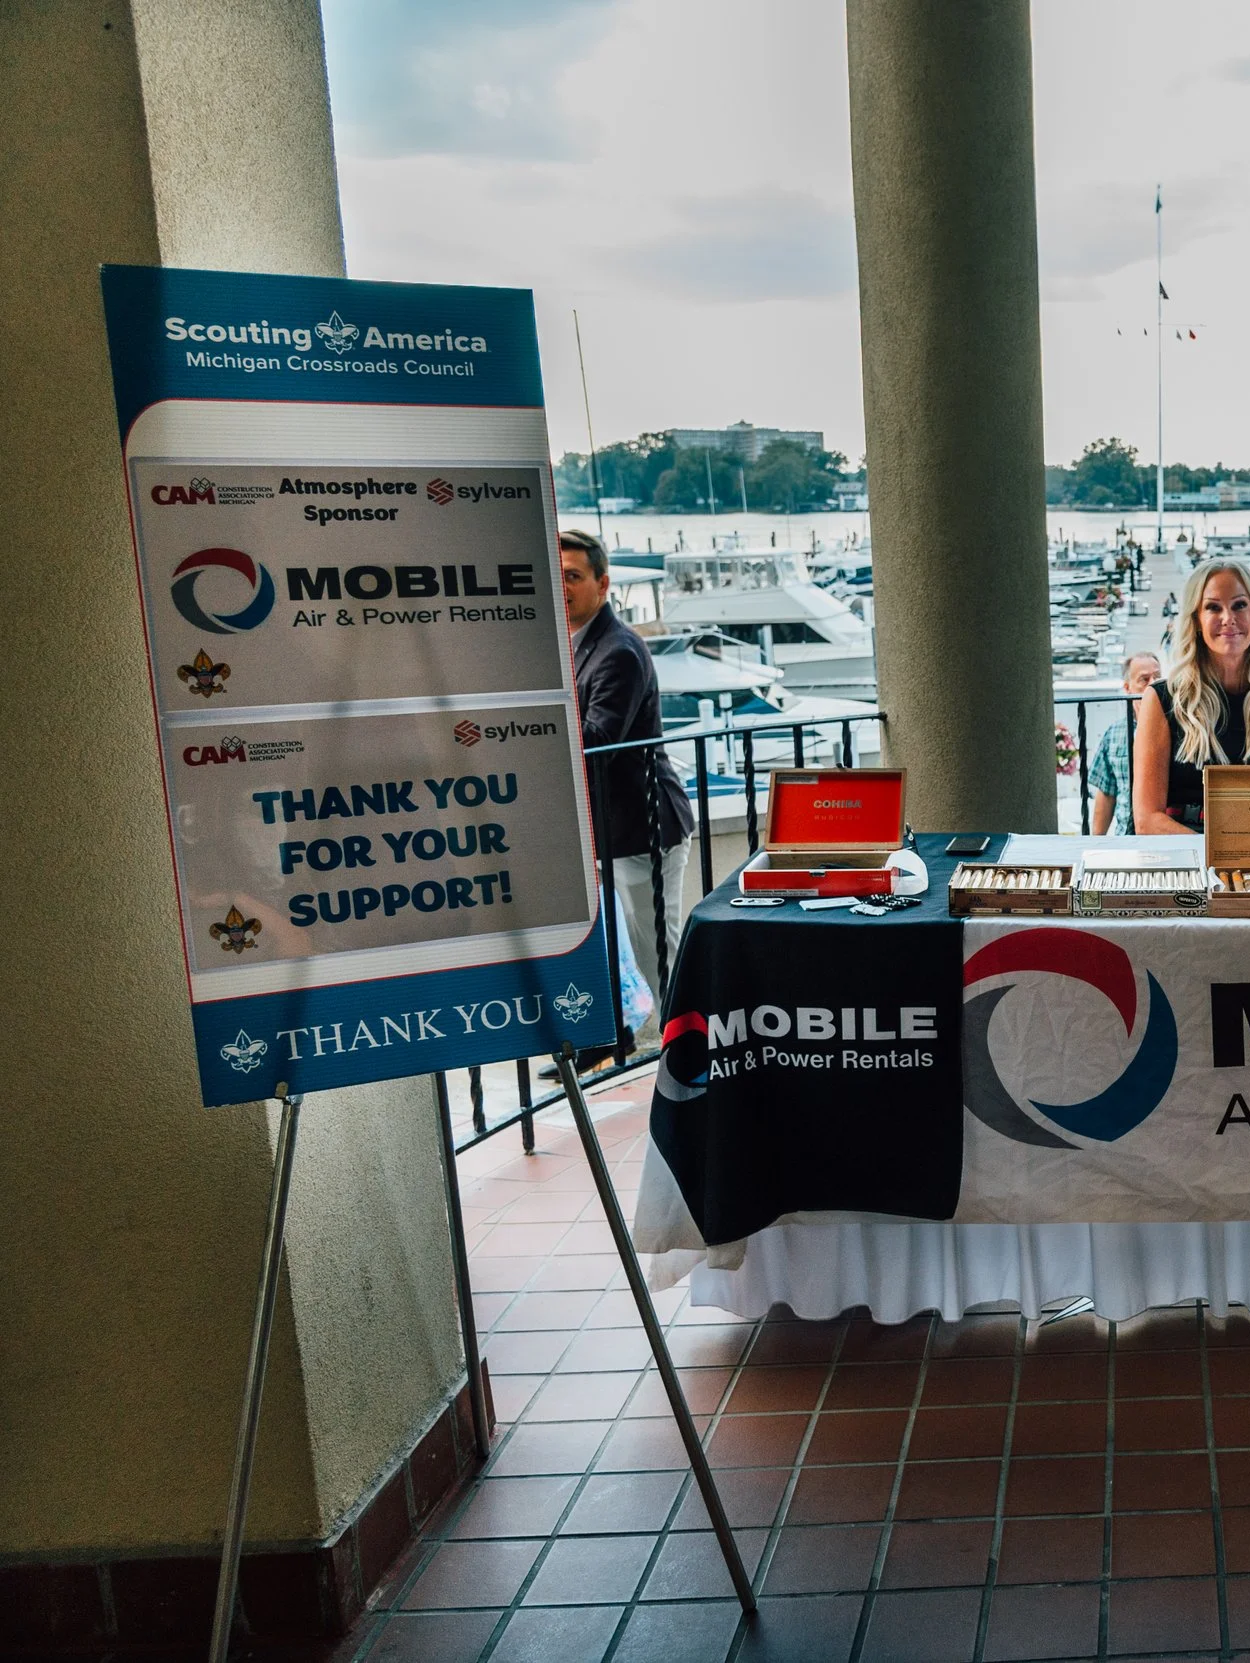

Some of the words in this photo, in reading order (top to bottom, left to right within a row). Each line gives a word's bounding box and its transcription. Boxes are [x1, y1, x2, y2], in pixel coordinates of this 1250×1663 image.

[165, 317, 312, 352] Scouting
[363, 326, 488, 353] America
[186, 351, 281, 372] Michigan
[286, 355, 399, 375] Crossroads
[403, 359, 475, 377] Council
[151, 484, 216, 506] CAM
[278, 477, 418, 499] Atmosphere
[457, 481, 531, 503] sylvan
[303, 505, 399, 527] Sponsor
[285, 563, 536, 602] MOBILE
[292, 608, 327, 628] Air
[336, 608, 356, 627] &
[362, 607, 441, 626] Power
[449, 603, 536, 623] Rentals
[248, 740, 303, 749] CONSTRUCTION
[484, 719, 557, 746] sylvan
[183, 744, 247, 767] CAM
[248, 747, 295, 756] ASSOCIATION
[249, 754, 286, 762] MICHIGAN
[252, 780, 419, 825] THANK
[424, 772, 518, 809] YOU
[813, 799, 862, 809] COHIBA
[280, 836, 377, 875] FOR
[382, 823, 510, 864] YOUR
[288, 870, 512, 928] SUPPORT!
[275, 1009, 447, 1061] THANK
[452, 994, 543, 1035] YOU
[706, 1004, 938, 1051] MOBILE
[708, 1054, 740, 1082] Air
[744, 1051, 757, 1070] &
[762, 1046, 835, 1070] Power
[842, 1048, 934, 1070] Rentals
